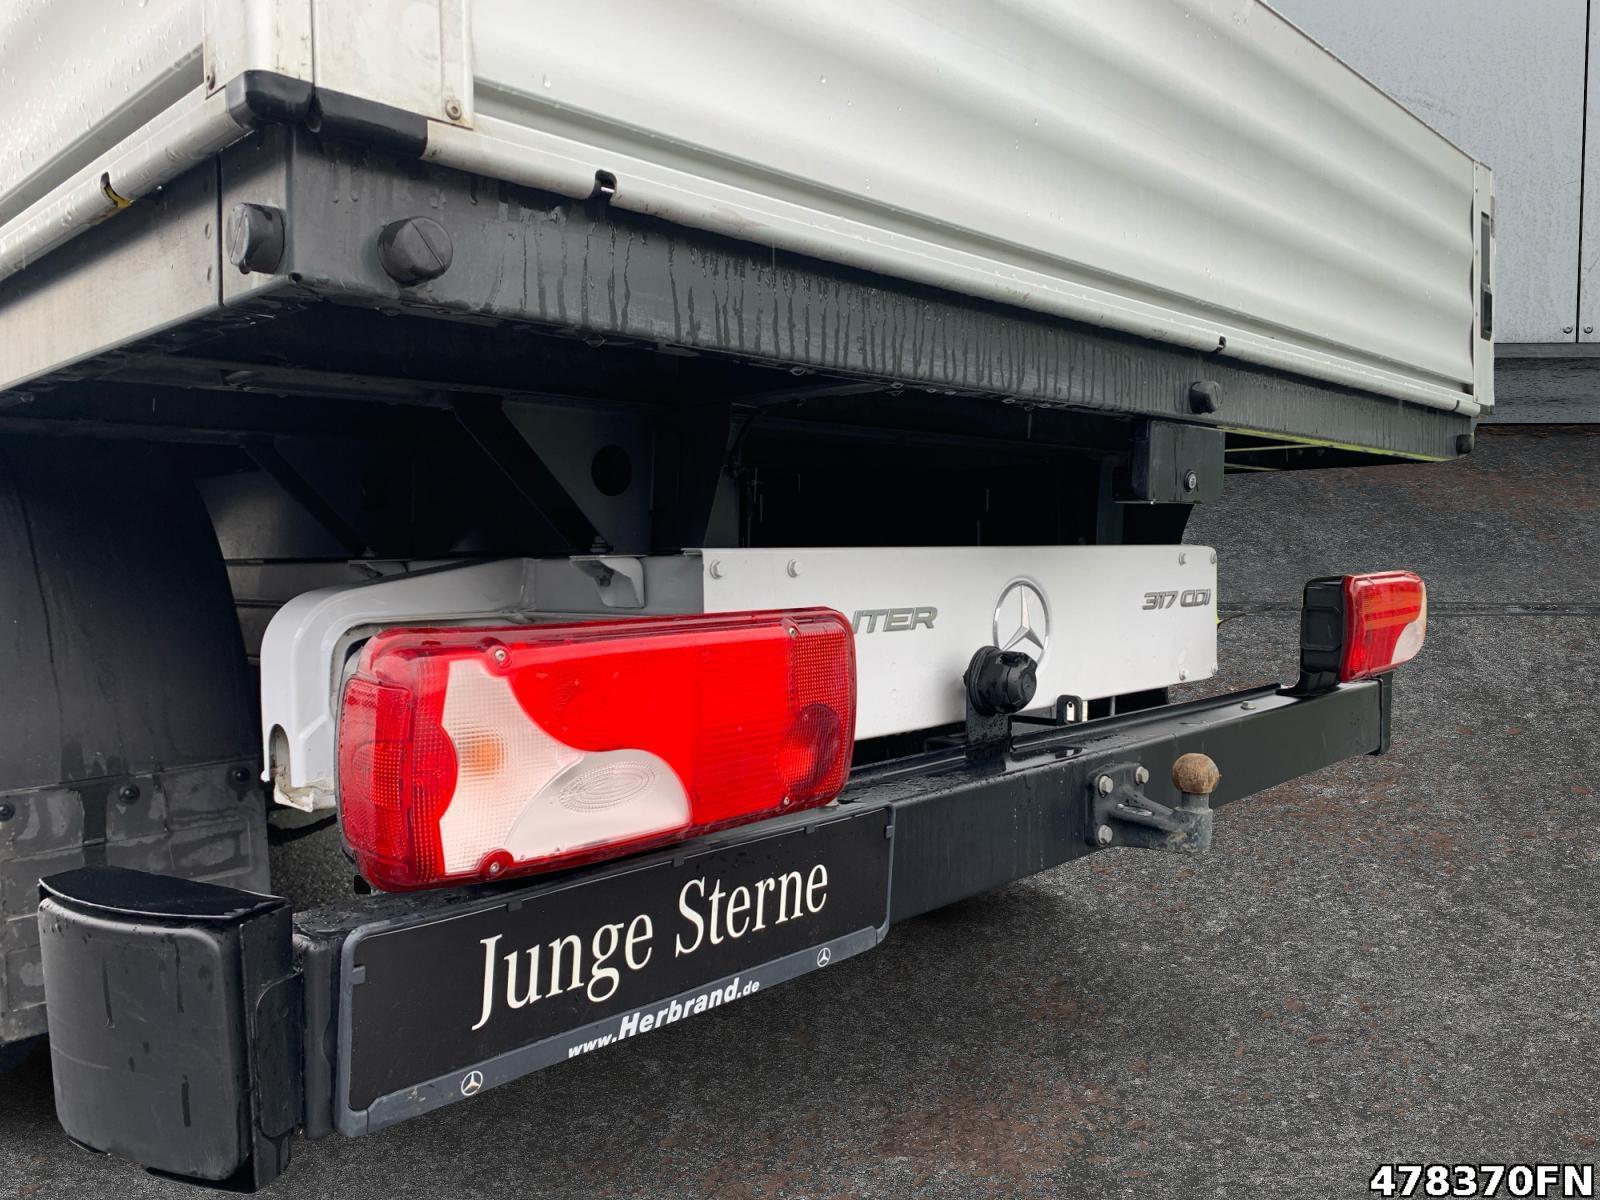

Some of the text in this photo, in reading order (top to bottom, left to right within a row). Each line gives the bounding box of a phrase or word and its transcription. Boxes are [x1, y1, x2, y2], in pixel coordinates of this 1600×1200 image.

[1142, 588, 1211, 610] 317 CDI
[471, 863, 828, 1030] Junge Sterne
[568, 977, 760, 1058] www.Herbrand.de
